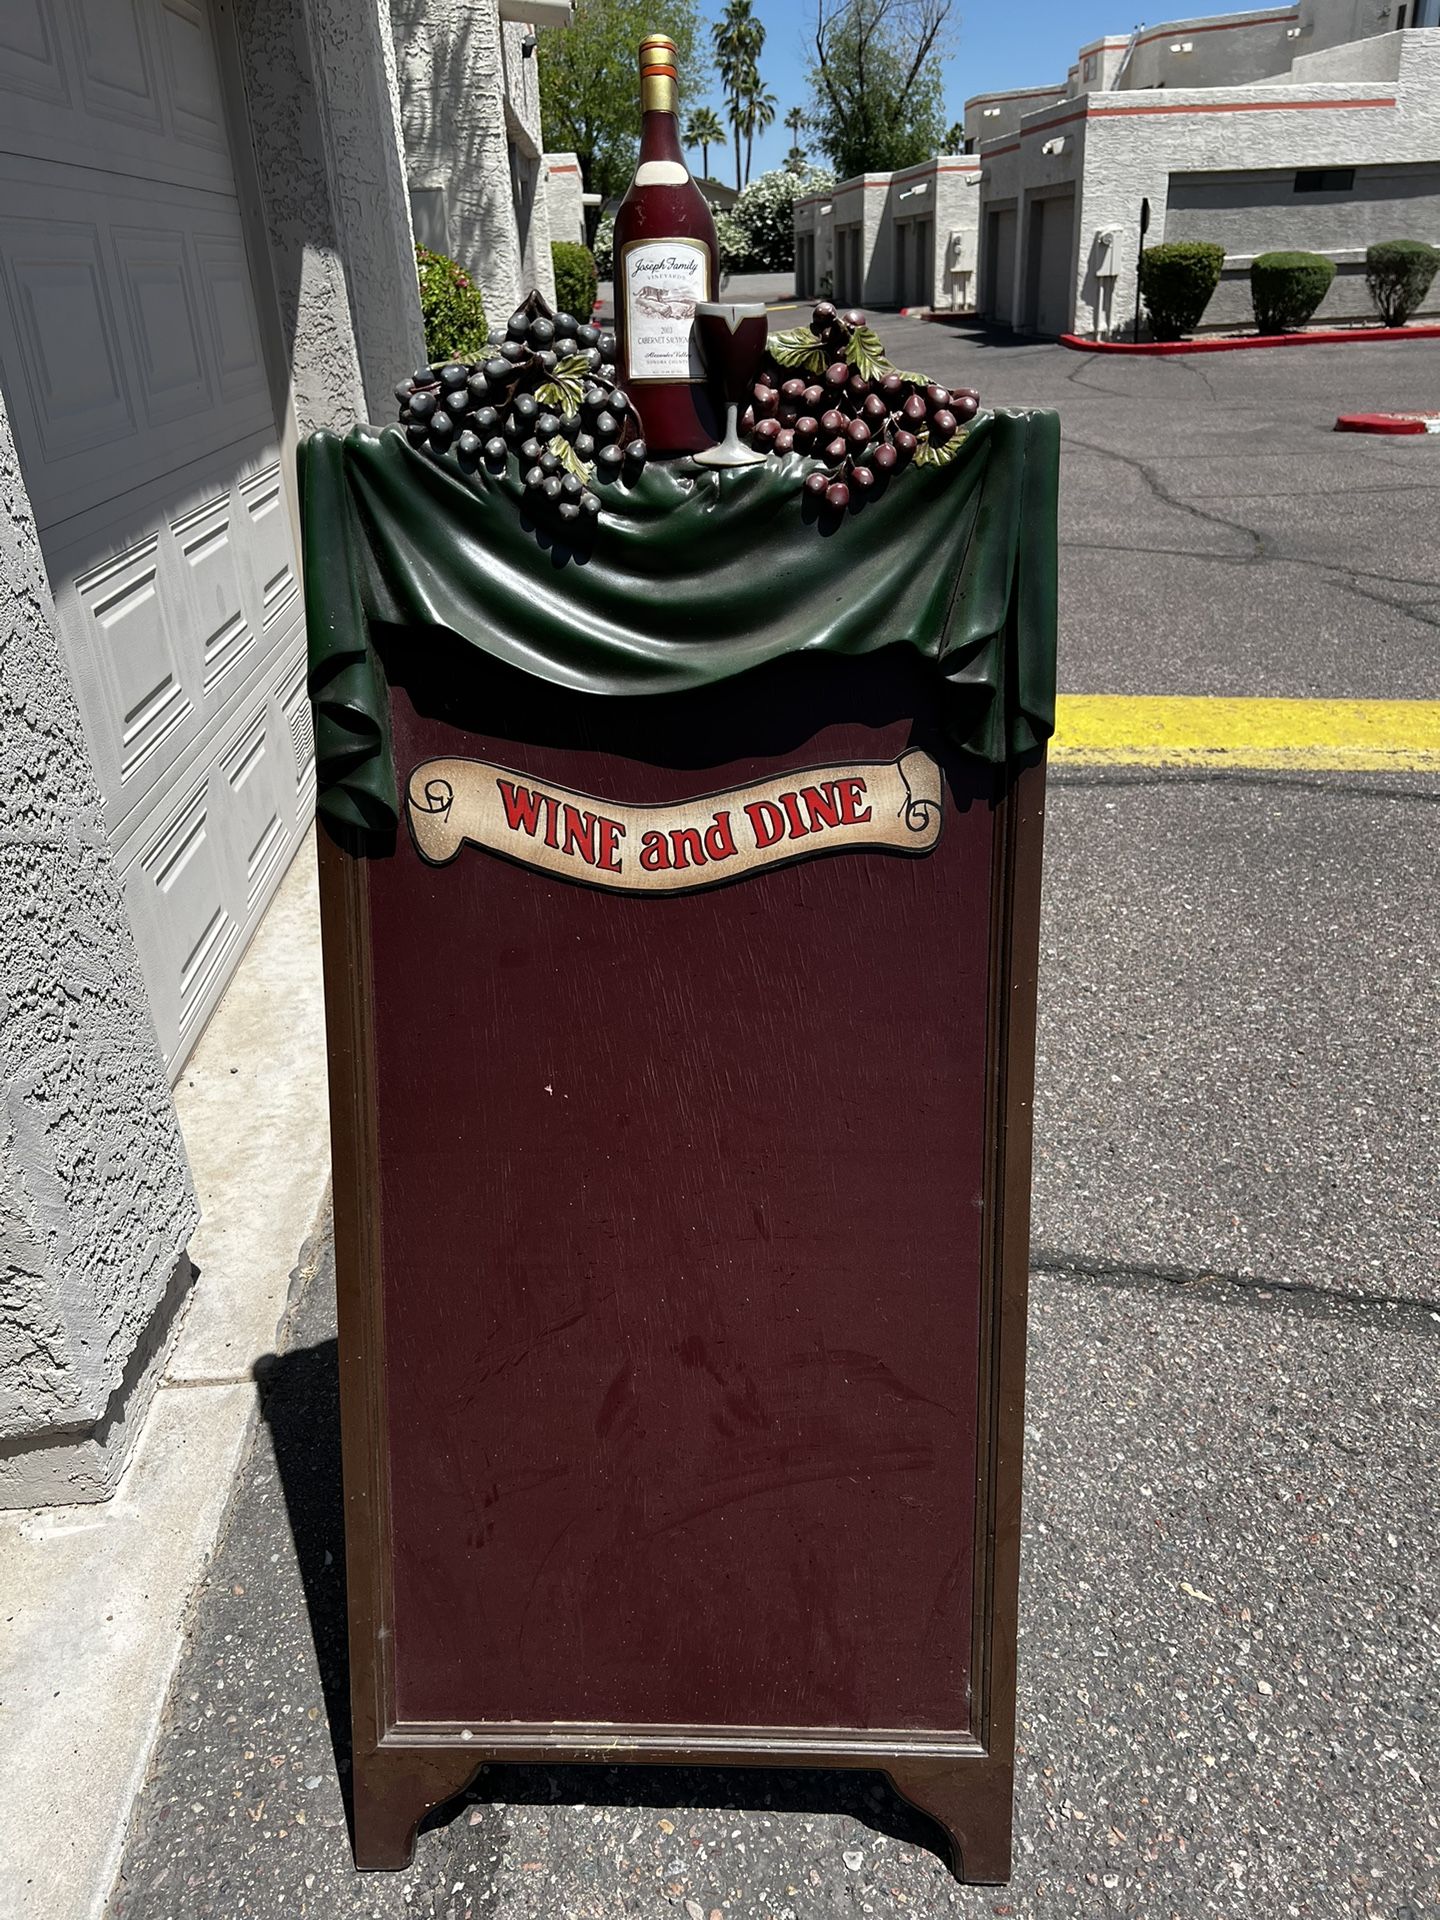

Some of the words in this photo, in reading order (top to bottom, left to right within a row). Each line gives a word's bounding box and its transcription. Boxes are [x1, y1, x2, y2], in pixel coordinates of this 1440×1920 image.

[632, 258, 666, 278] Joseph
[666, 257, 698, 276] Family
[647, 273, 686, 281] VINEYARDS
[638, 336, 665, 344] CABERNET
[496, 777, 626, 875] WINE
[639, 811, 738, 872] and
[744, 776, 874, 850] DINE
